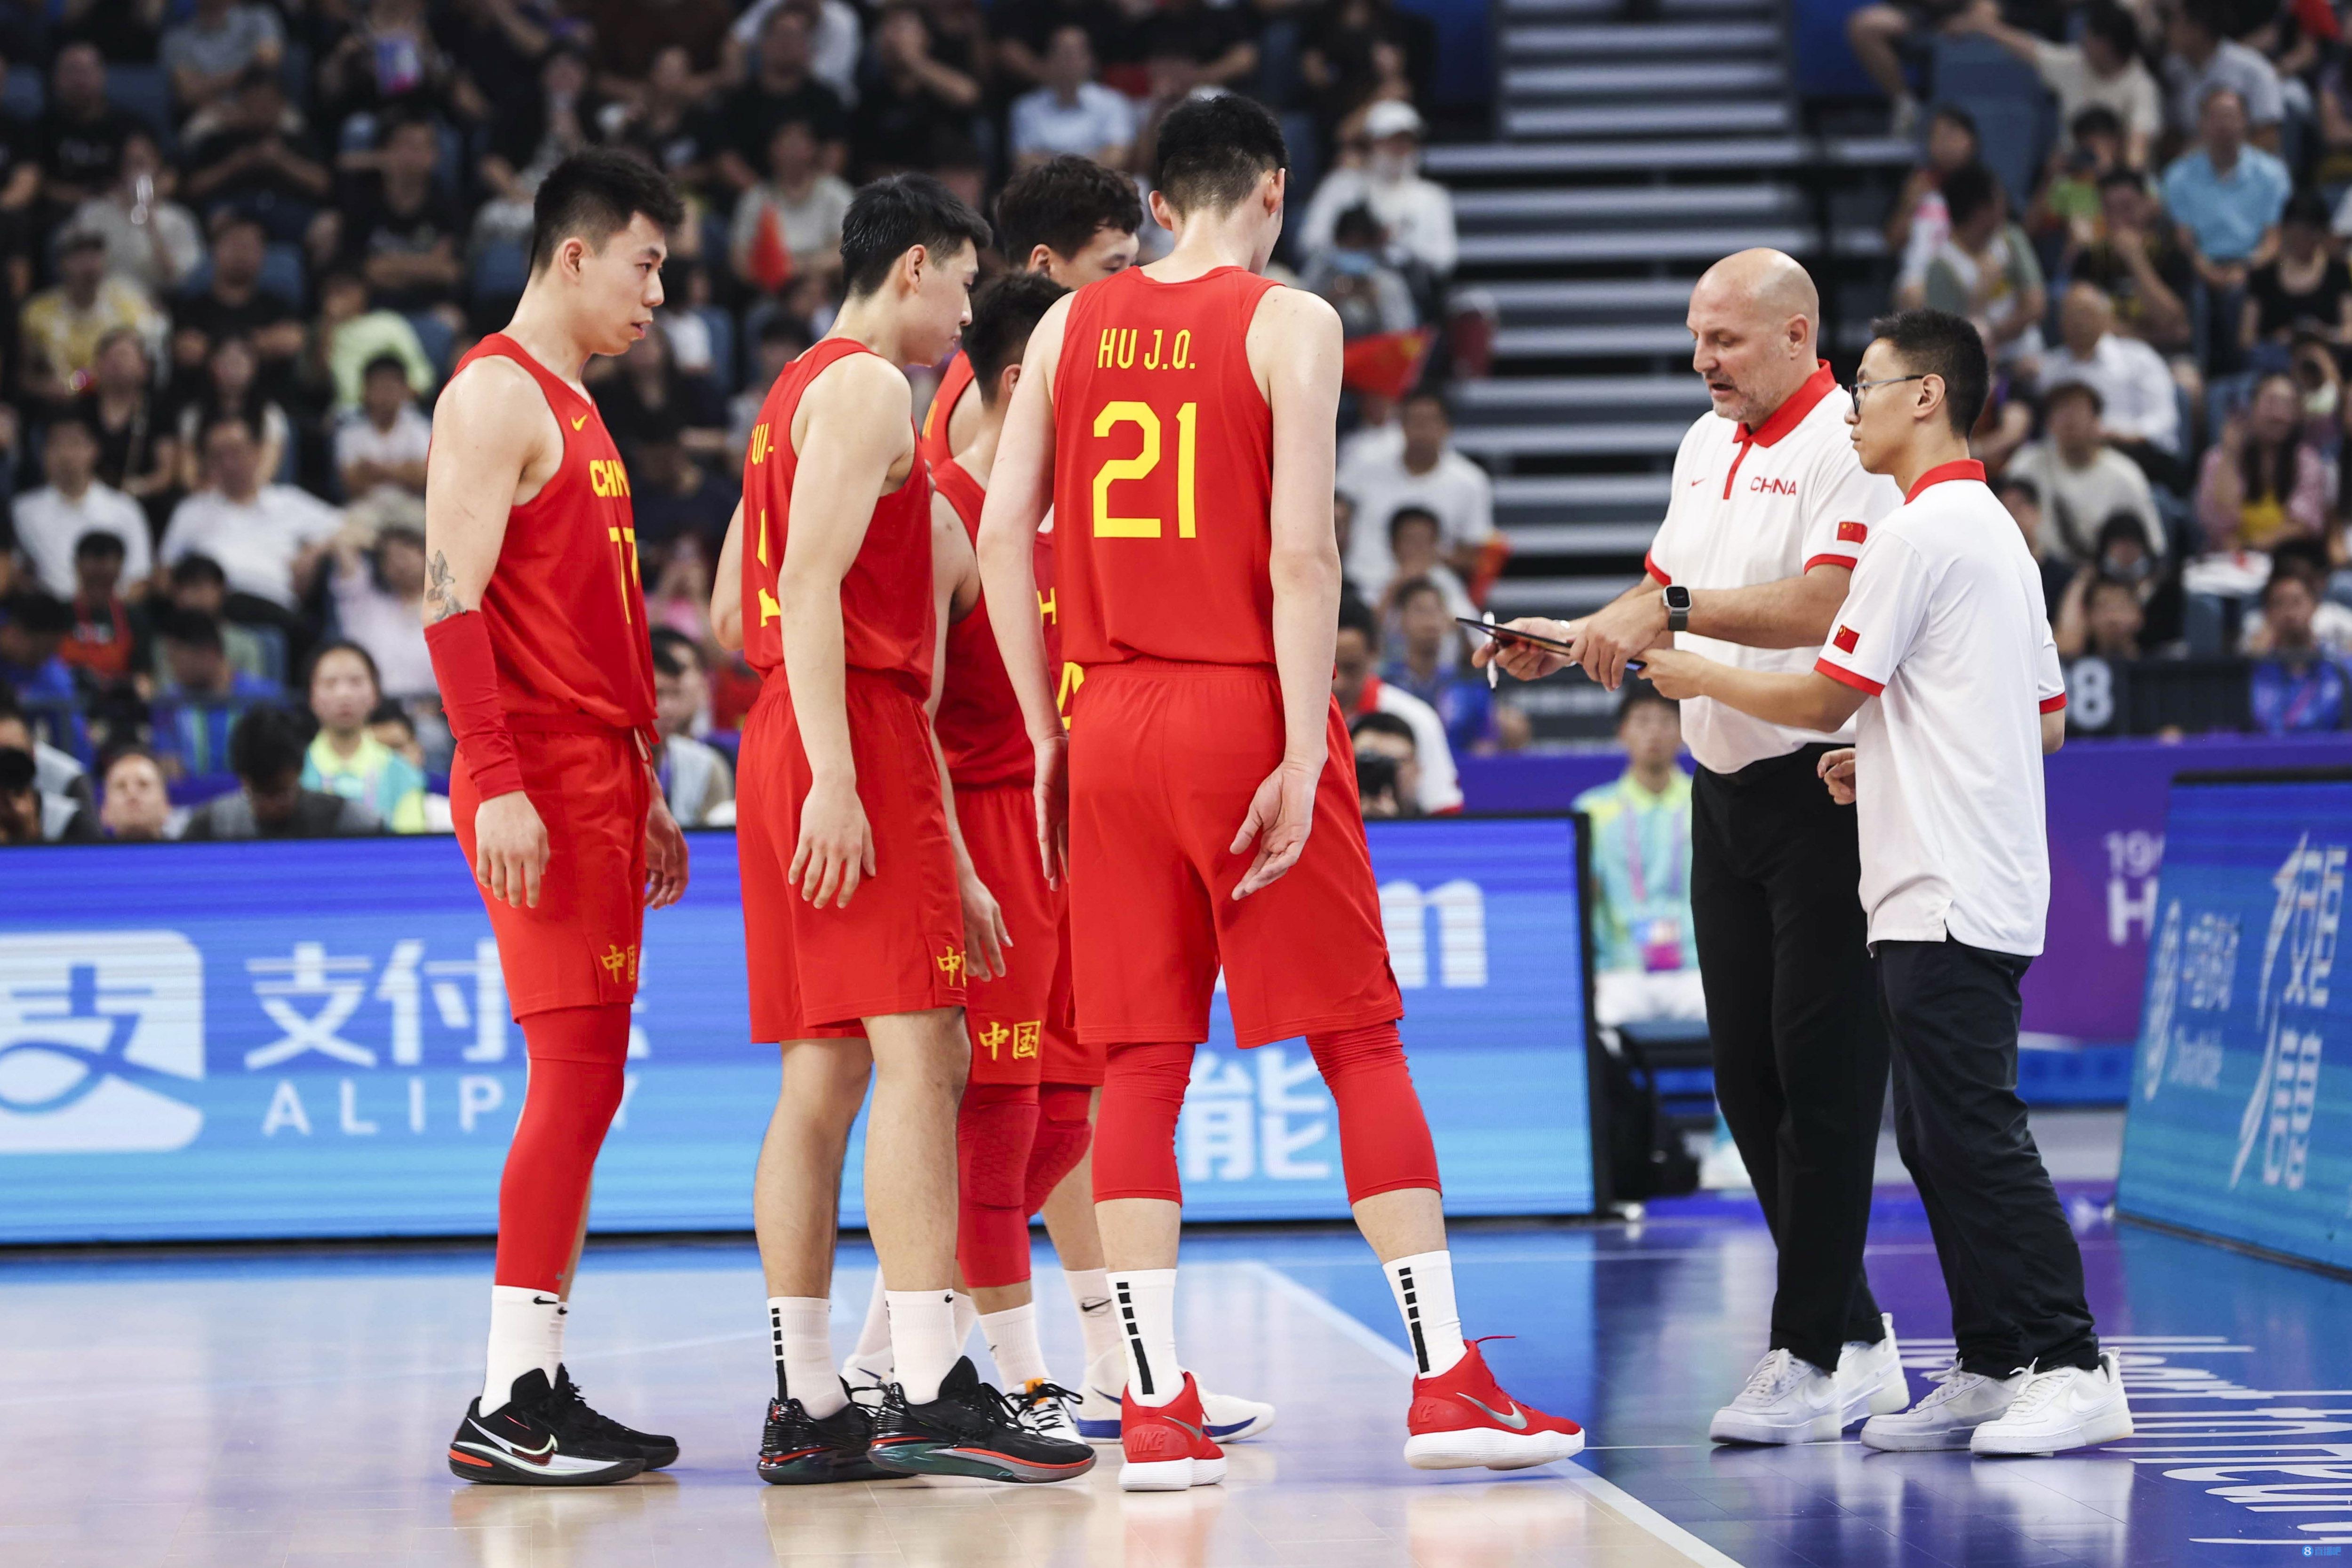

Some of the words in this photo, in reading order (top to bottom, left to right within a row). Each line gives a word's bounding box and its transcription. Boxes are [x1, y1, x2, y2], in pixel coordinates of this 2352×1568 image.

[1098, 328, 1137, 369] HU
[1144, 329, 1196, 370] J.Q.
[1093, 401, 1196, 538] 21
[608, 527, 638, 625] 77
[937, 946, 967, 987] 中
[245, 938, 651, 1069] 支付
[979, 1020, 1041, 1061] 中国
[262, 1075, 639, 1136] ALIPY
[1130, 1431, 1168, 1453] NIKE
